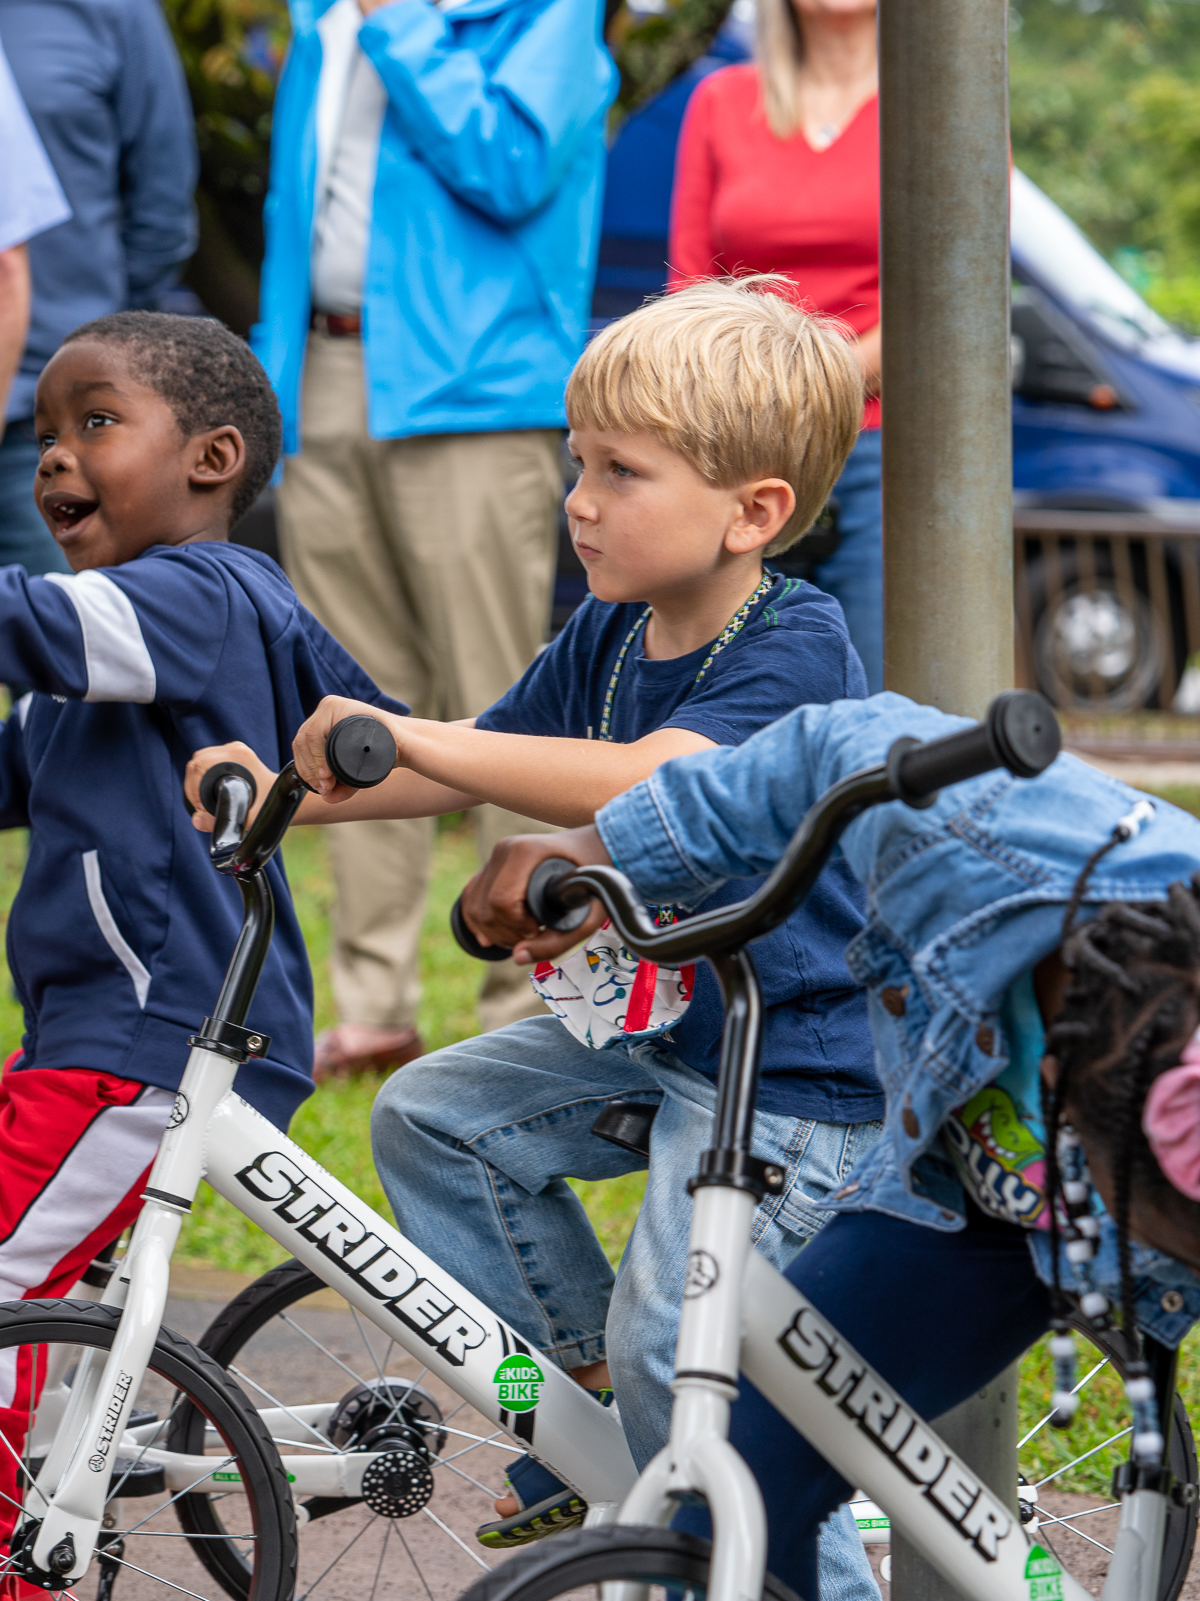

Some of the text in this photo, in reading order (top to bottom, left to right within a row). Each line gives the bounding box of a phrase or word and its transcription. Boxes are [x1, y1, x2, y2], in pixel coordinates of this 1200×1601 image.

[234, 1151, 487, 1367] STRIDER
[95, 1371, 134, 1456] STRIDER
[497, 1383, 540, 1400] BIKE
[505, 1366, 540, 1380] KIDS
[776, 1306, 1014, 1563] STRIDER
